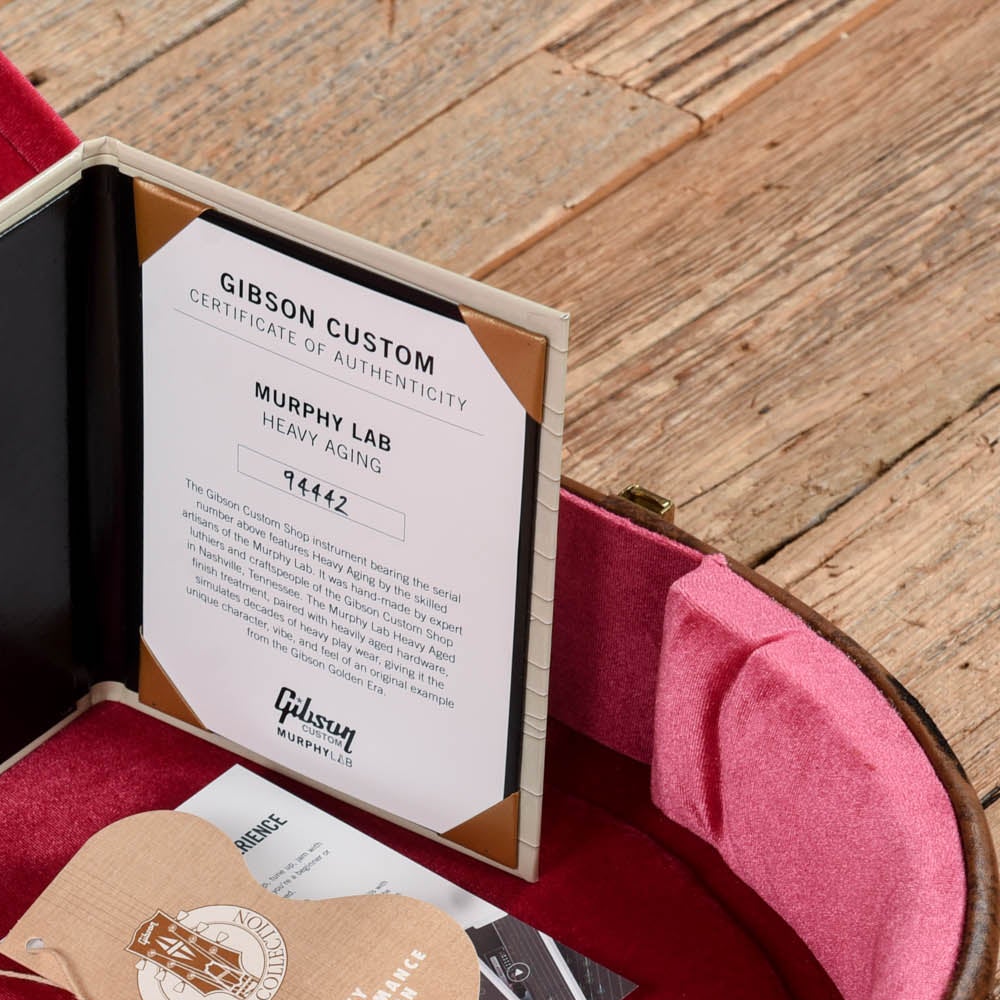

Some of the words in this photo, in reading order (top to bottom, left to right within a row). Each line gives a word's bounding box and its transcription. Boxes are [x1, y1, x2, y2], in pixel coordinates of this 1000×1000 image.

[189, 287, 297, 347] CERTIFICATE
[304, 337, 327, 356] OF
[333, 349, 468, 412] AUTHENTICITY
[219, 271, 315, 329] GIBSON
[326, 316, 435, 376] CUSTOM
[254, 381, 344, 433] MURPHY
[351, 421, 392, 453] LAB
[262, 410, 319, 447] HEAVY
[324, 438, 382, 475] AGING
[283, 469, 349, 517] 94442
[185, 477, 204, 496] The
[205, 487, 241, 513] Gibson
[242, 504, 281, 530] Custom
[283, 522, 311, 543] Shop
[312, 535, 368, 568] instrument
[370, 559, 410, 587] bearing
[412, 576, 430, 592] the
[432, 585, 462, 605] serial
[186, 539, 197, 552] in
[198, 544, 246, 577] Nashville,
[247, 566, 303, 601] Tennessee.
[306, 593, 326, 611] The
[328, 602, 369, 630] Murphy
[370, 620, 391, 638] Lab
[392, 630, 426, 654] Heavy
[427, 644, 456, 664] Aged
[191, 556, 218, 578] finish
[220, 570, 271, 603] treatment,
[273, 596, 305, 617] paired
[307, 610, 329, 627] with
[330, 618, 366, 644] heavily
[367, 637, 394, 655] aged
[396, 646, 449, 678] hardware,
[246, 626, 270, 646] from
[271, 638, 289, 654] the
[290, 646, 326, 671] Gibson
[327, 663, 364, 687] Golden
[366, 679, 387, 697] Era.
[274, 686, 356, 755] Gibson
[301, 723, 343, 748] CUSTOM
[234, 814, 288, 854] RIENCE
[233, 909, 285, 1000] COLLECTION
